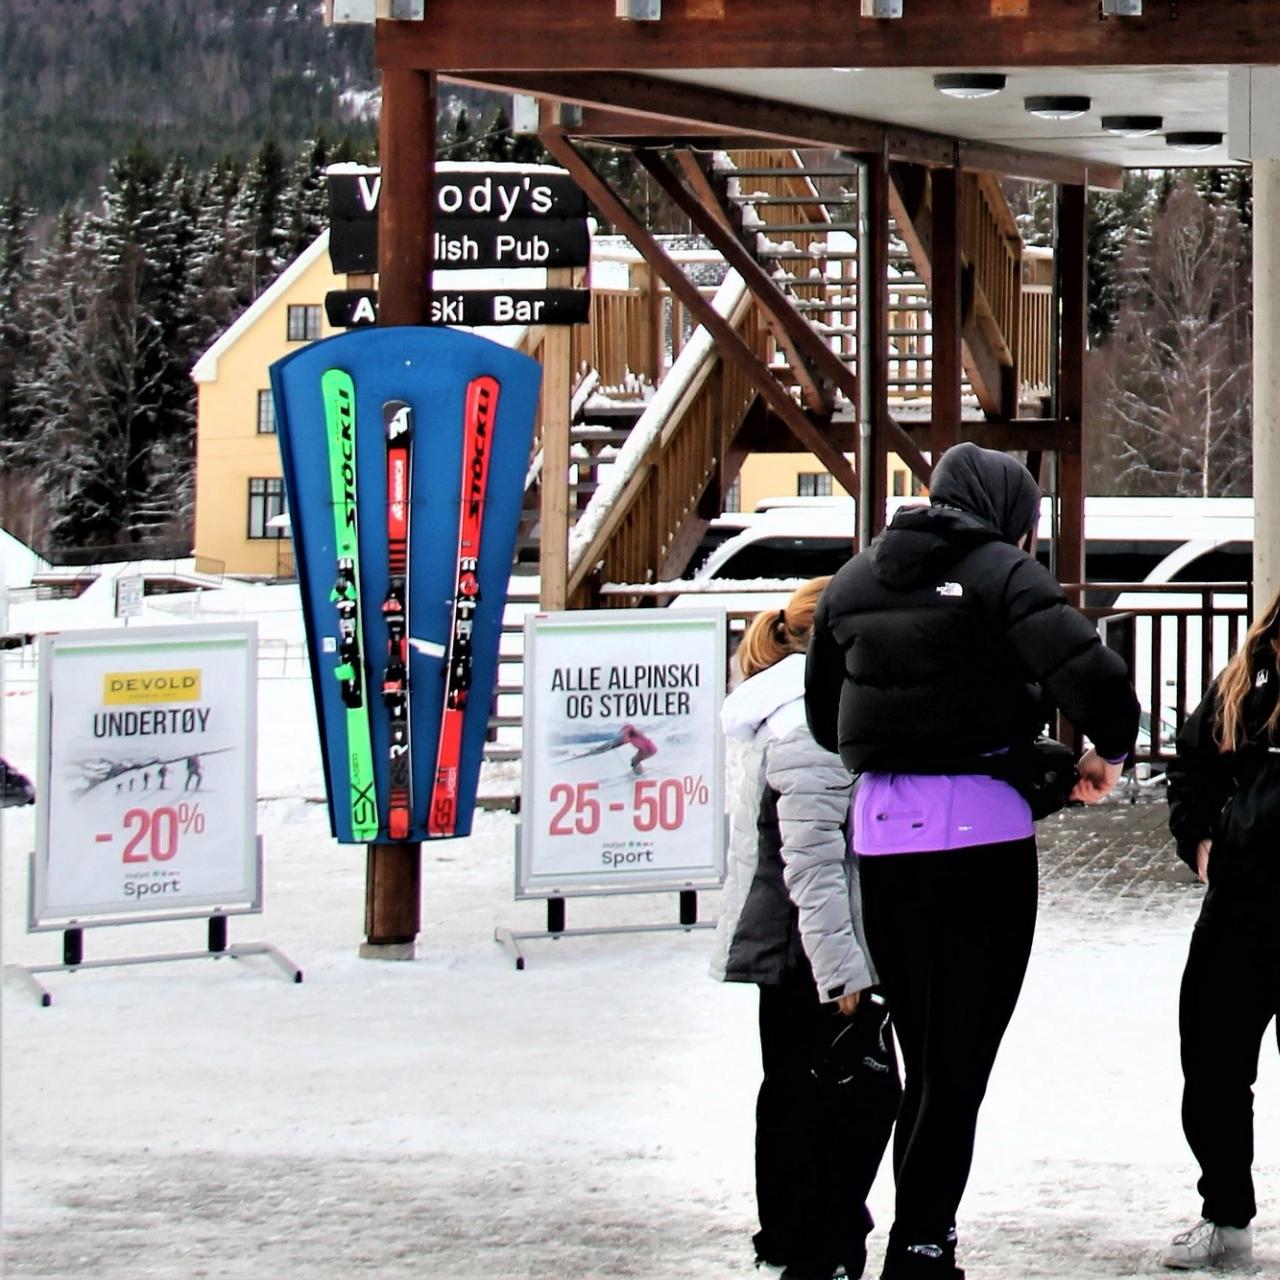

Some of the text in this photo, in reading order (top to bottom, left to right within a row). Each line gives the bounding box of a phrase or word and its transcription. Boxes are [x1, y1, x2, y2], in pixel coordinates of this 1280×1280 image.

[496, 235, 550, 261] Pub
[493, 295, 545, 322] Bar
[110, 676, 197, 692] DEVOLD
[551, 663, 700, 692] ALLE ALPINSKI
[566, 691, 691, 719] OG STØVLER
[94, 707, 211, 738] UNDERTØY
[548, 782, 601, 837] 25
[632, 775, 709, 833] 50%
[121, 802, 206, 864] 20%
[601, 848, 654, 869] Sport
[123, 877, 181, 901] Sport
